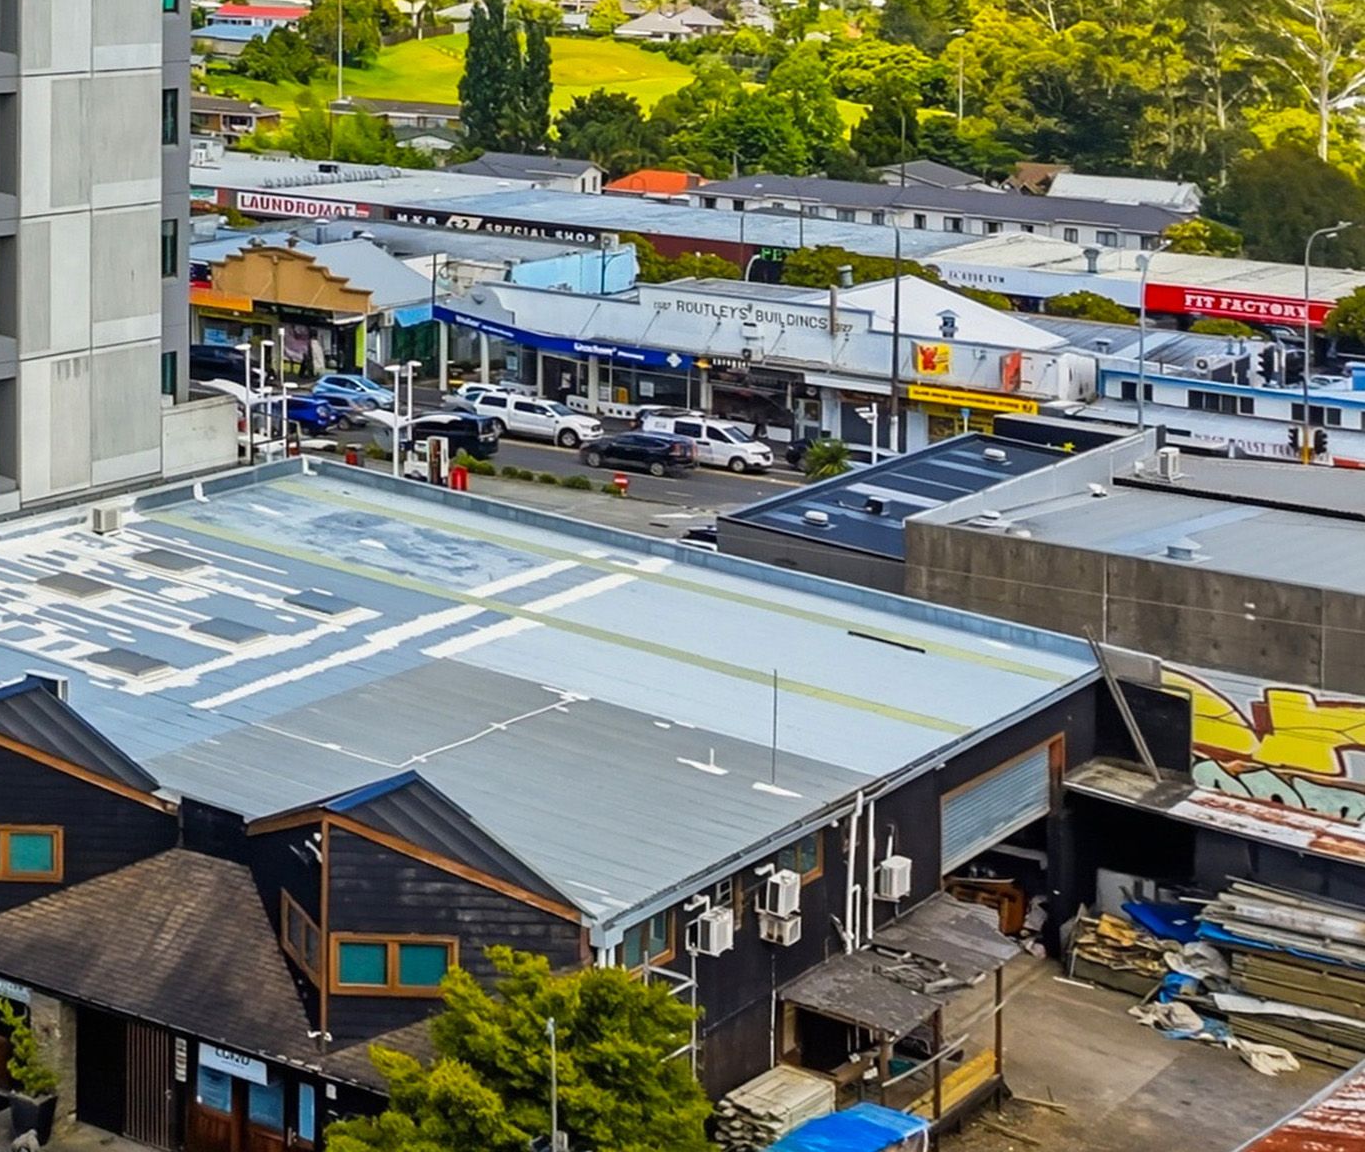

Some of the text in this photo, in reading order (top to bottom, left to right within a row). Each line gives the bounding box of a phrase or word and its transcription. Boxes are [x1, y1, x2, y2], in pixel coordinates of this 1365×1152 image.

[240, 194, 353, 218] LAUNDROMAT
[555, 231, 596, 243] SHOP
[1184, 294, 1307, 318] FIT FACTORY
